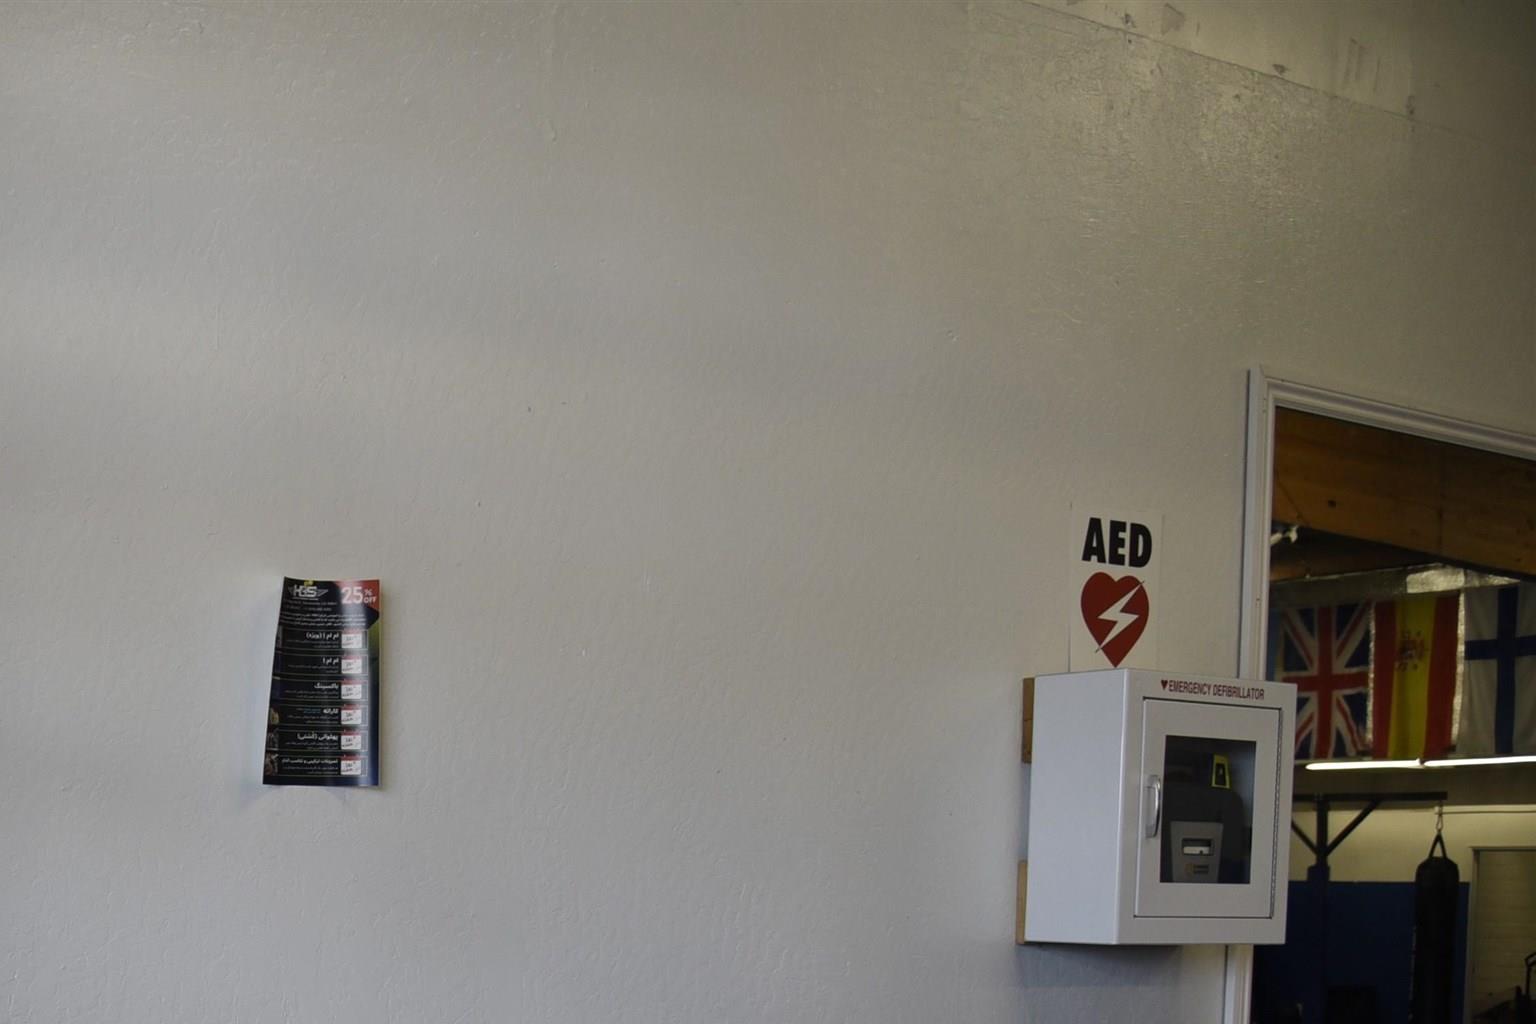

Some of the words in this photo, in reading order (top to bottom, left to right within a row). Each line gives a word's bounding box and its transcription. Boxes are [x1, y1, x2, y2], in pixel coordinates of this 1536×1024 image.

[1082, 517, 1152, 568] AED
[363, 596, 378, 604] OFF
[1168, 680, 1211, 697] EMERGENCY
[1213, 684, 1265, 700] DEFIBRILLATOR
